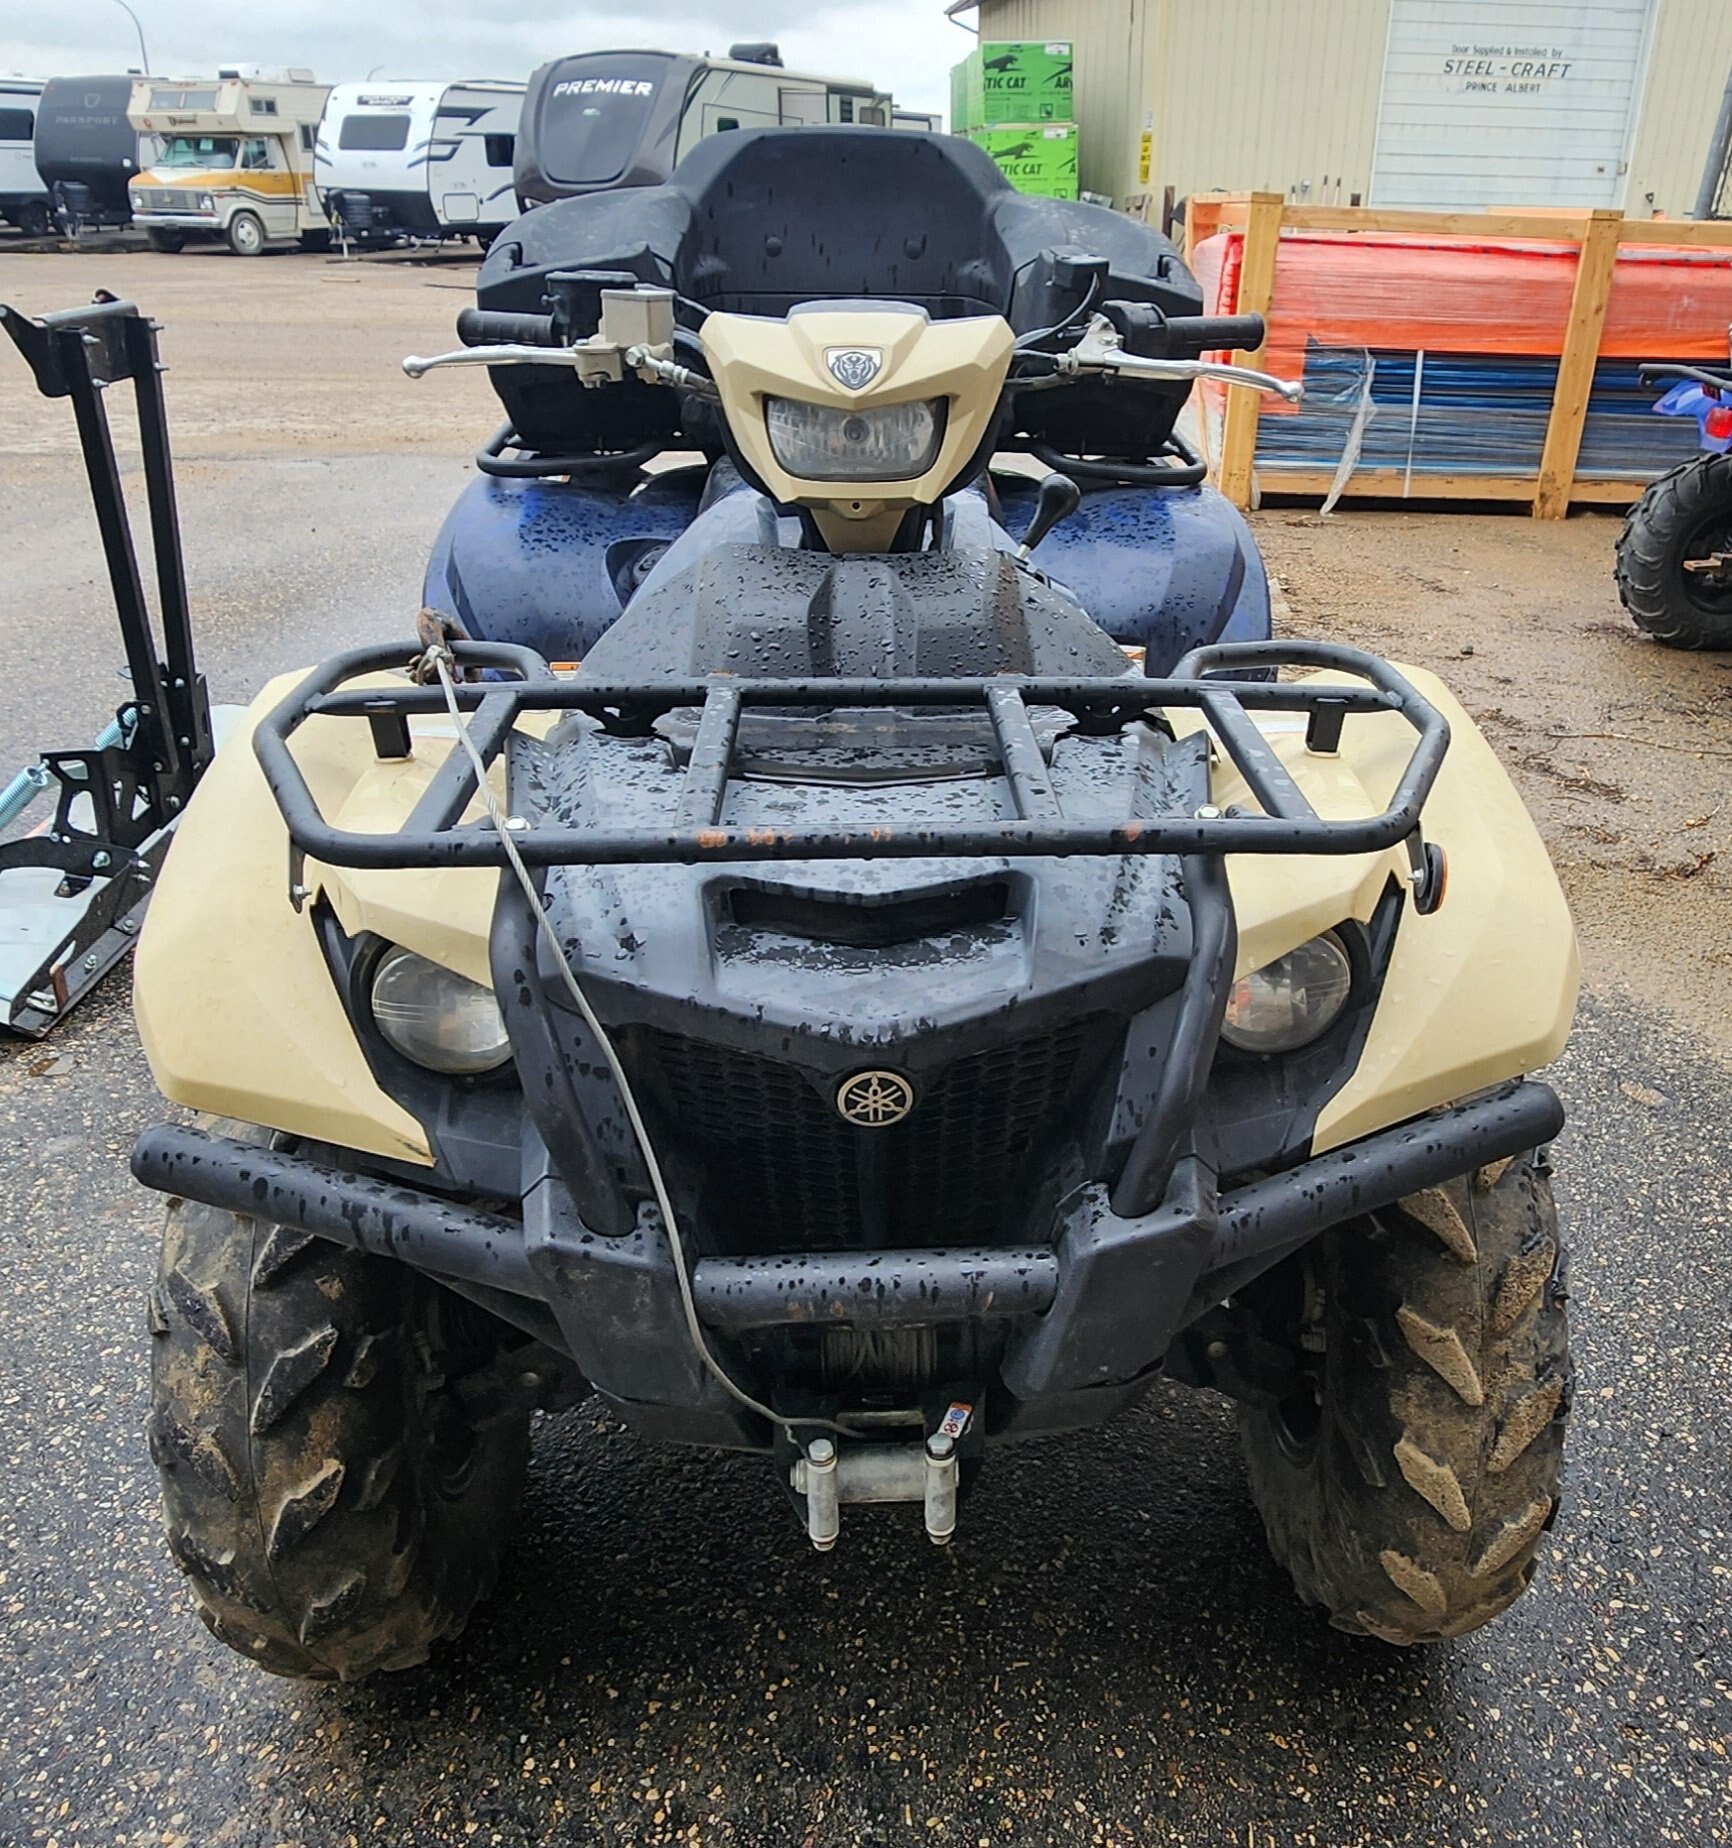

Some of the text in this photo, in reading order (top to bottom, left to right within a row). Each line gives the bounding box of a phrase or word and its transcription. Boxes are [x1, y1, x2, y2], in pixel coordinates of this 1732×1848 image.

[1452, 44, 1470, 54] Door
[1473, 45, 1504, 56] Supplied
[1552, 47, 1563, 57] by
[1443, 59, 1494, 75] STEEL
[1511, 61, 1572, 77] CRAFT
[553, 78, 653, 97] PREMIER
[1007, 77, 1026, 89] CAT
[1465, 81, 1541, 93] PRINCE ALBERT
[55, 115, 119, 125] PASSPORT
[1022, 163, 1043, 175] CAT
